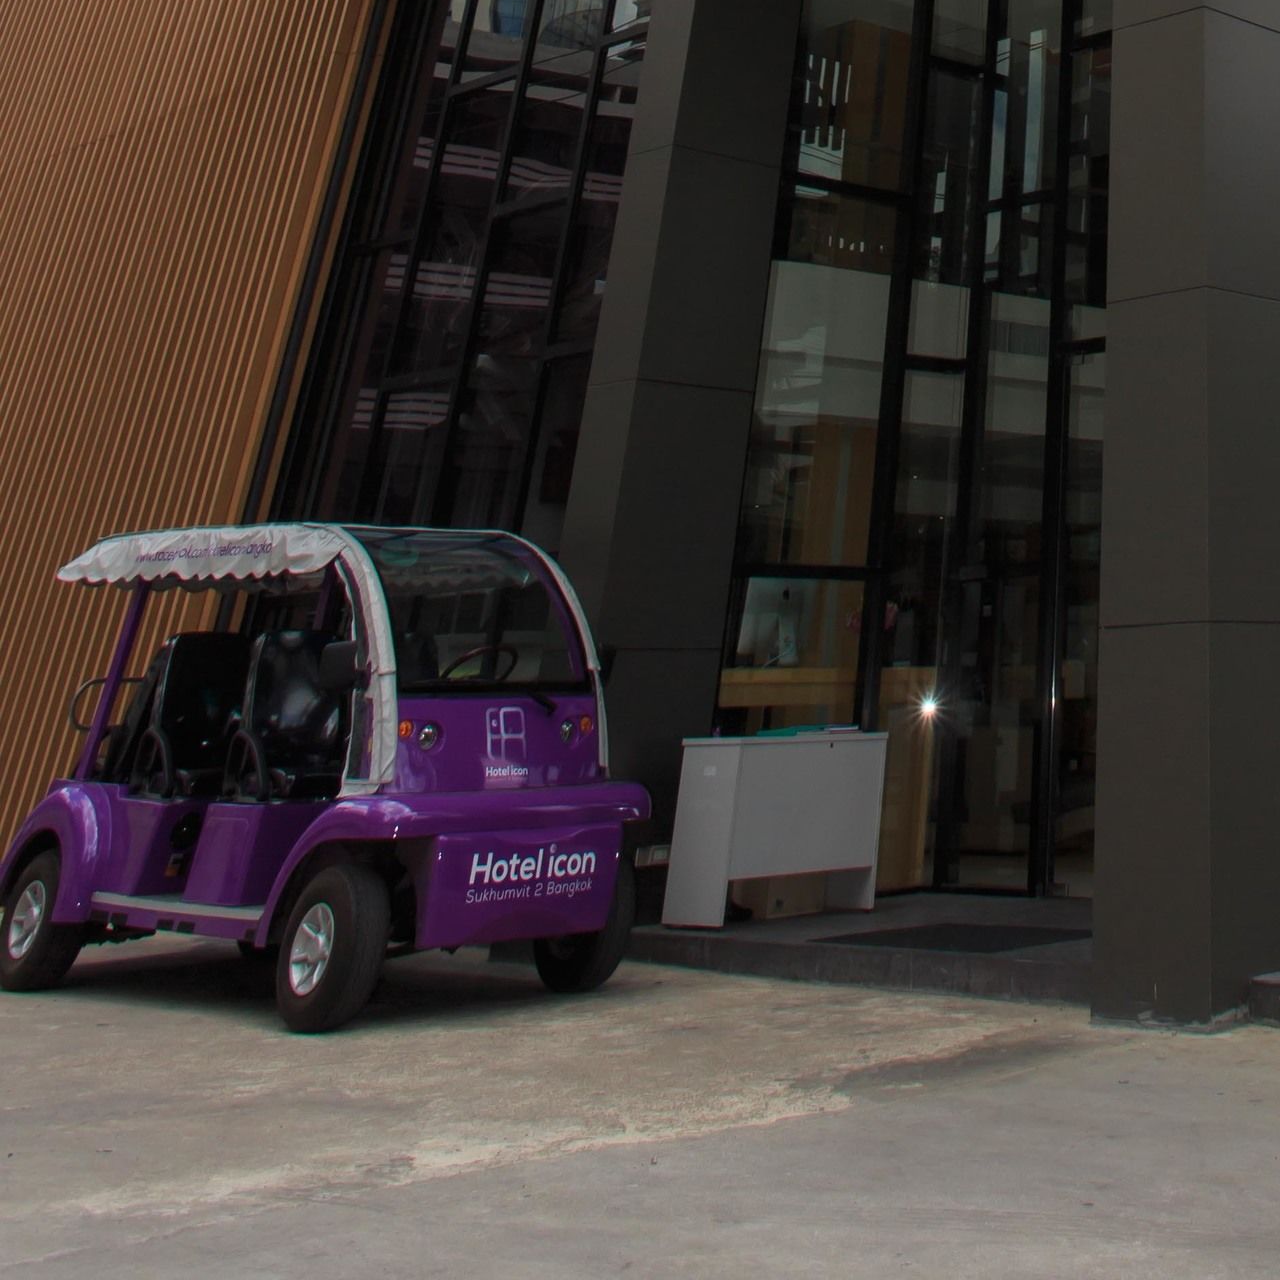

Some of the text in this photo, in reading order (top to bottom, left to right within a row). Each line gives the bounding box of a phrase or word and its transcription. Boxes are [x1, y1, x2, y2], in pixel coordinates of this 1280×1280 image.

[485, 763, 529, 777] Hotel icon
[468, 843, 597, 885] Hotel icon
[465, 877, 593, 904] Sukhumvit 2 Bangkok
